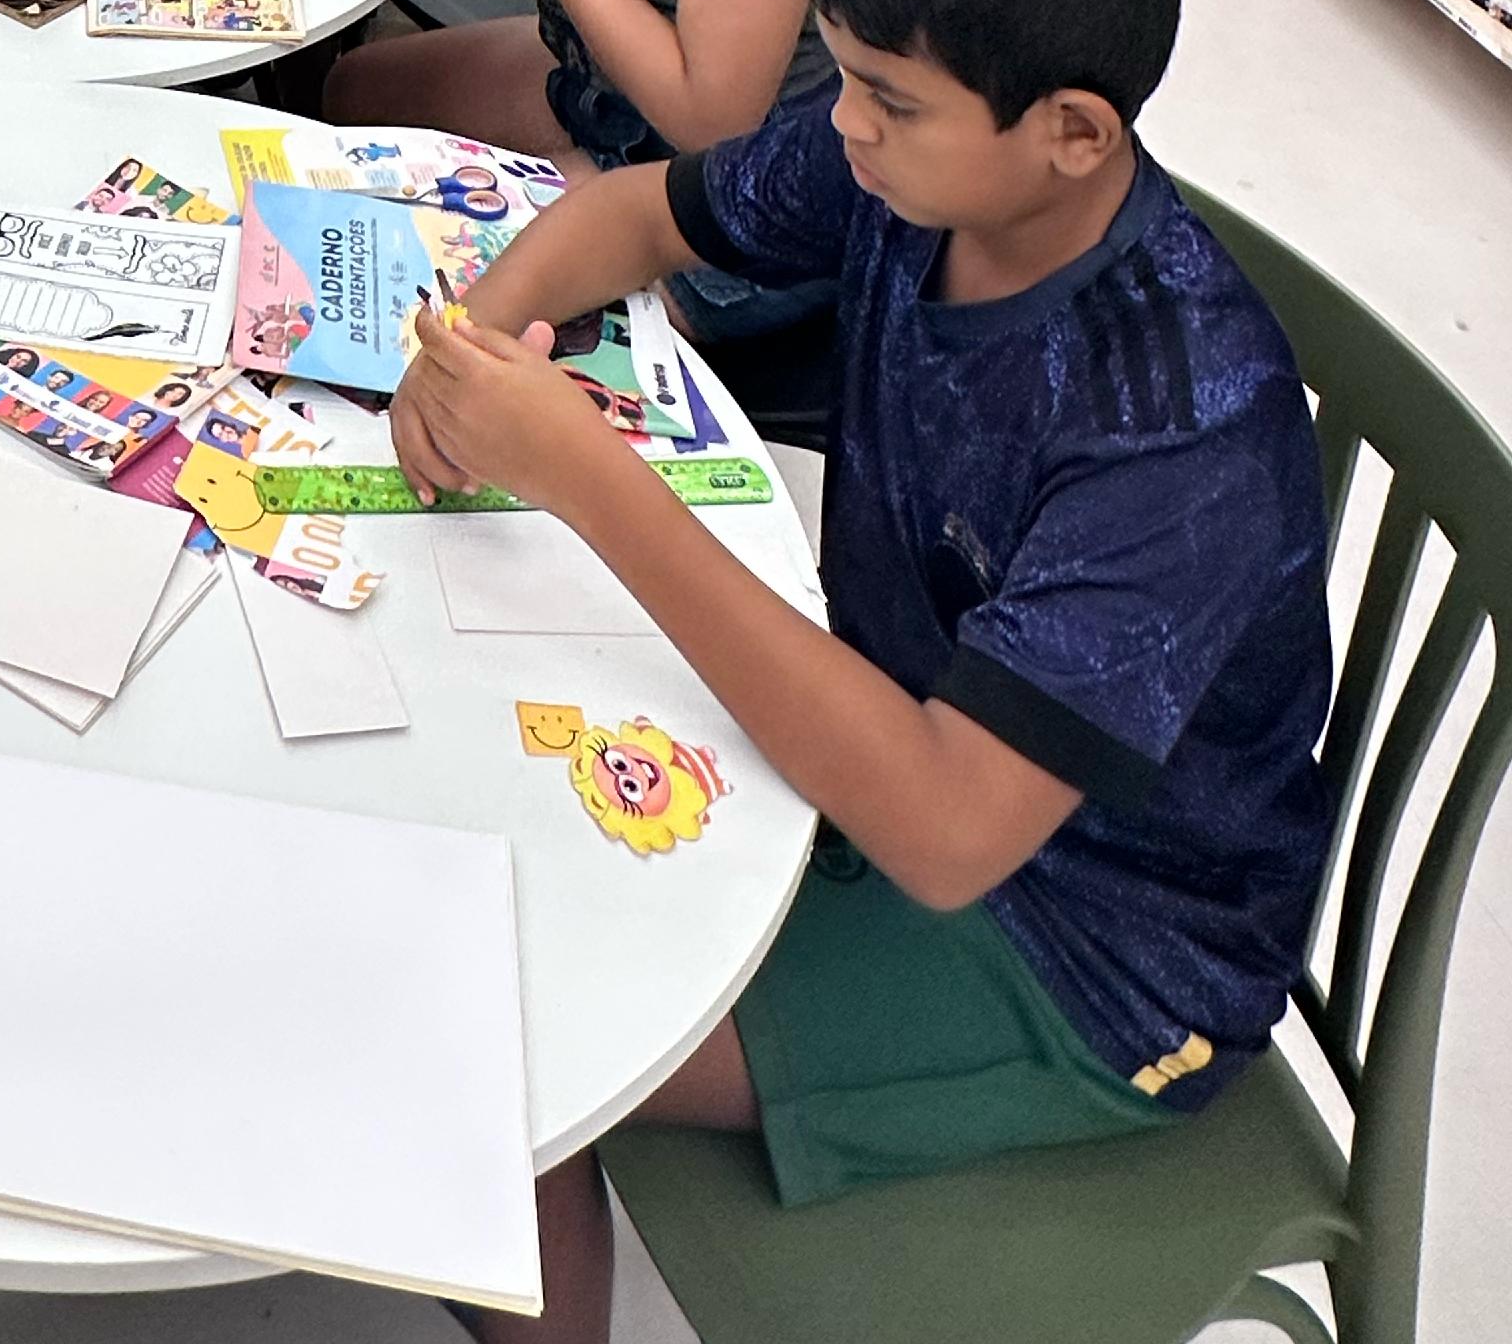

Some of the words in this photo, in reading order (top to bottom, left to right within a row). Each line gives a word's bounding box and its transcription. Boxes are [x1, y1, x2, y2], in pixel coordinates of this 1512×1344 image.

[320, 227, 345, 324] CADERNO
[344, 218, 372, 321] ORIENTAÇÕES
[349, 322, 368, 345] DE
